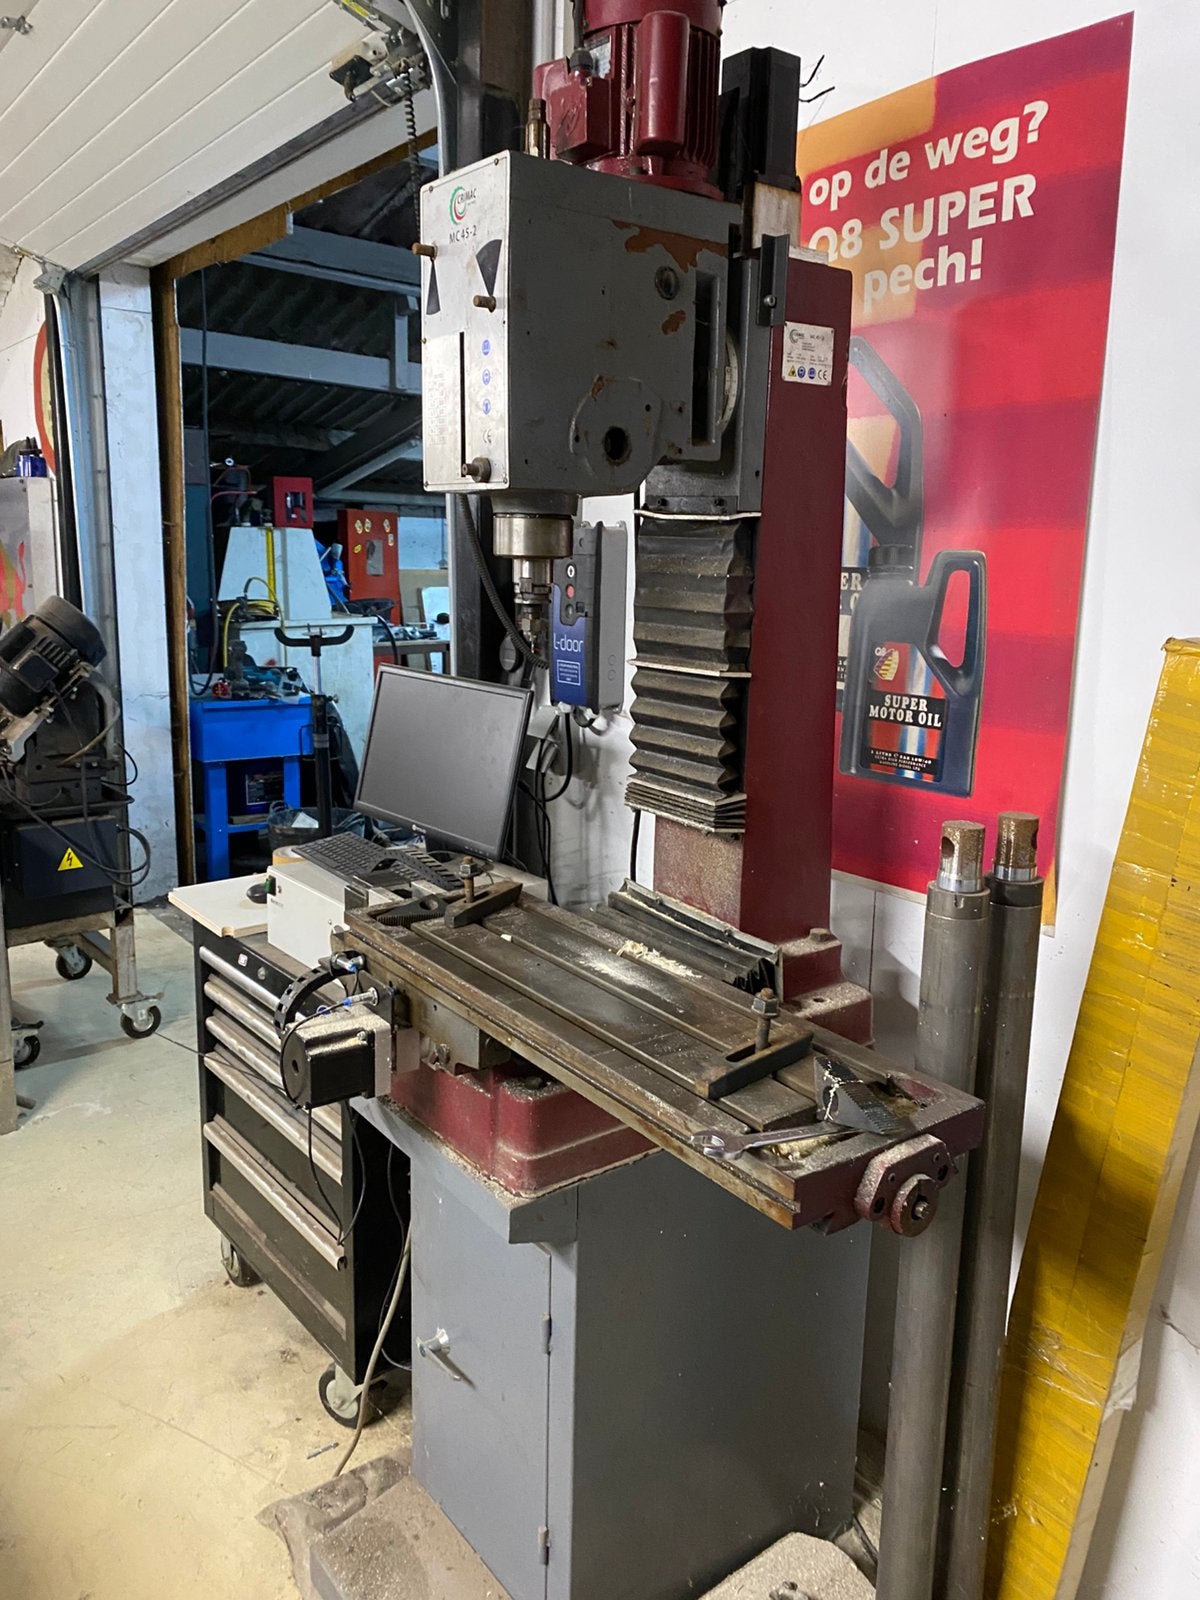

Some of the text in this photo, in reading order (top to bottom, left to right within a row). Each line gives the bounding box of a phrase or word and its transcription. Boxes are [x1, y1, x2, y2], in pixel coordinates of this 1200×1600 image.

[809, 100, 1049, 211] op de weg?
[808, 173, 1037, 263] Q8 SUPER
[863, 237, 983, 317] pech!
[868, 704, 942, 728] MOTOR OIL
[884, 694, 928, 712] SUPER
